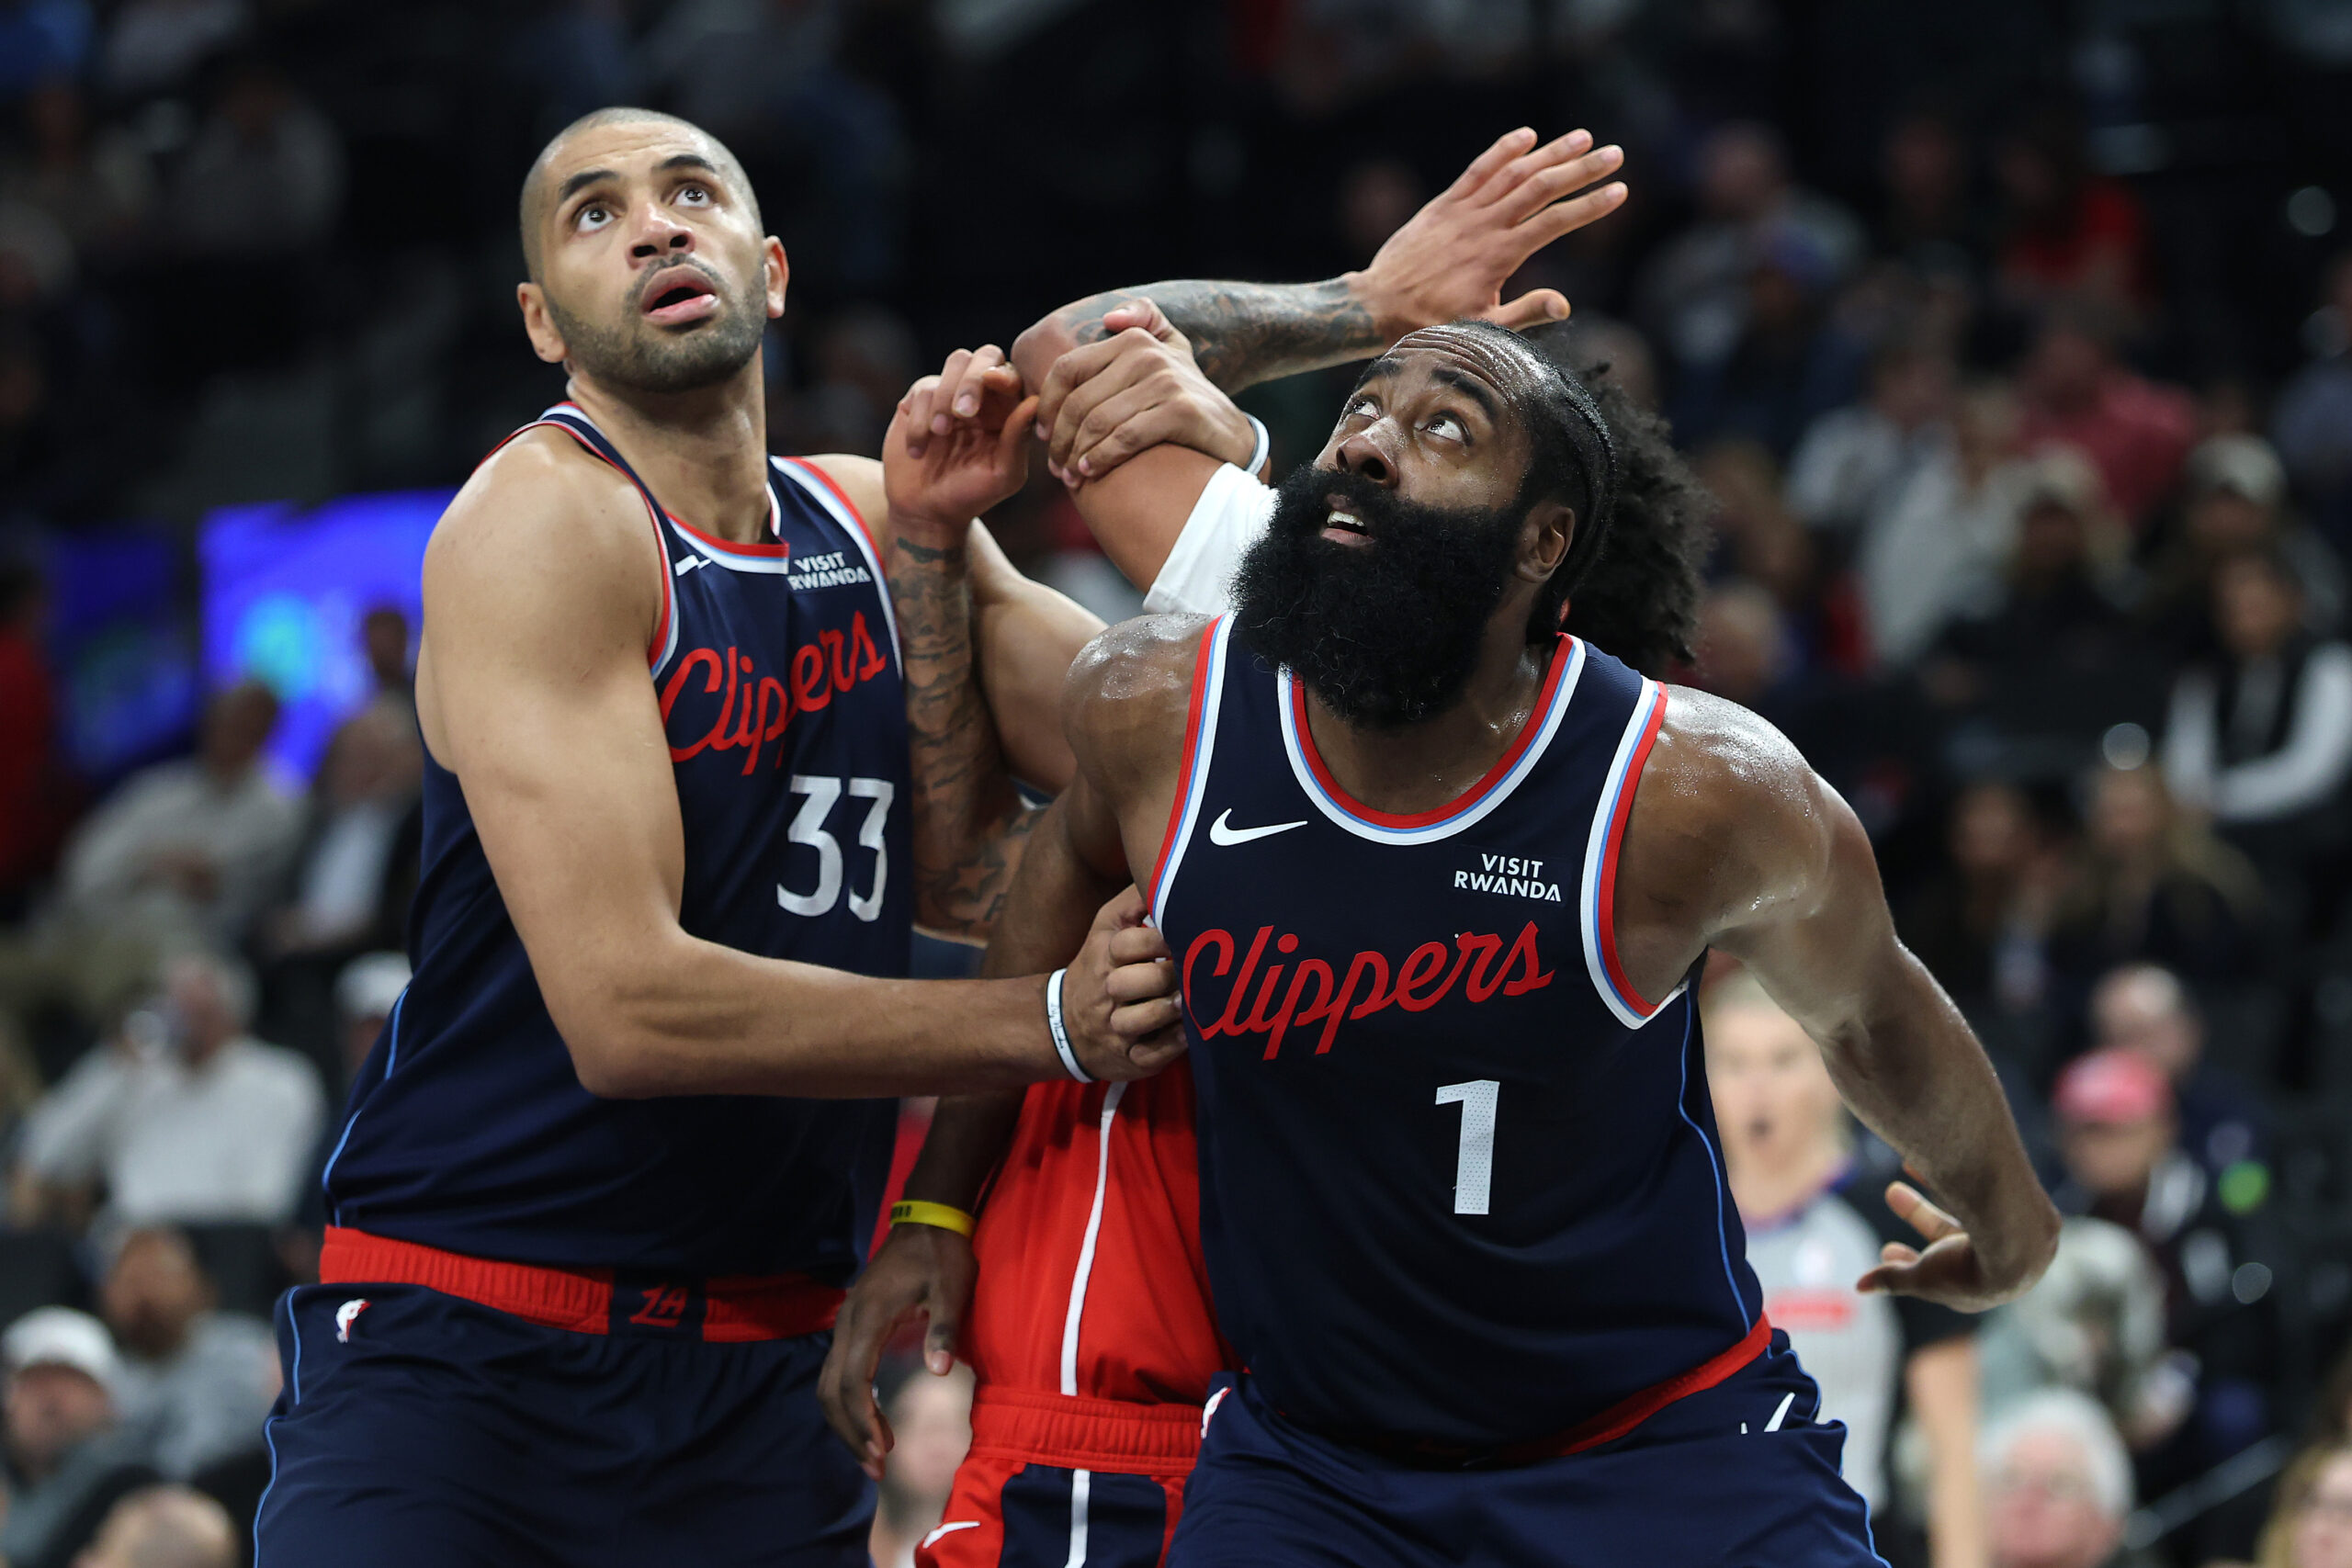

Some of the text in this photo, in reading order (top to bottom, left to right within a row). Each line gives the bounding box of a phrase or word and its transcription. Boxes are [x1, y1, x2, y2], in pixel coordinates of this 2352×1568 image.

[787, 566, 872, 591] RWANDA
[794, 551, 845, 572] VISIT
[660, 610, 887, 775] Clipers
[776, 774, 894, 921] 33
[1453, 870, 1562, 902] RWANDA
[1481, 853, 1544, 878] VISIT
[1182, 920, 1555, 1060] Clippers
[1435, 1079, 1500, 1214] 1
